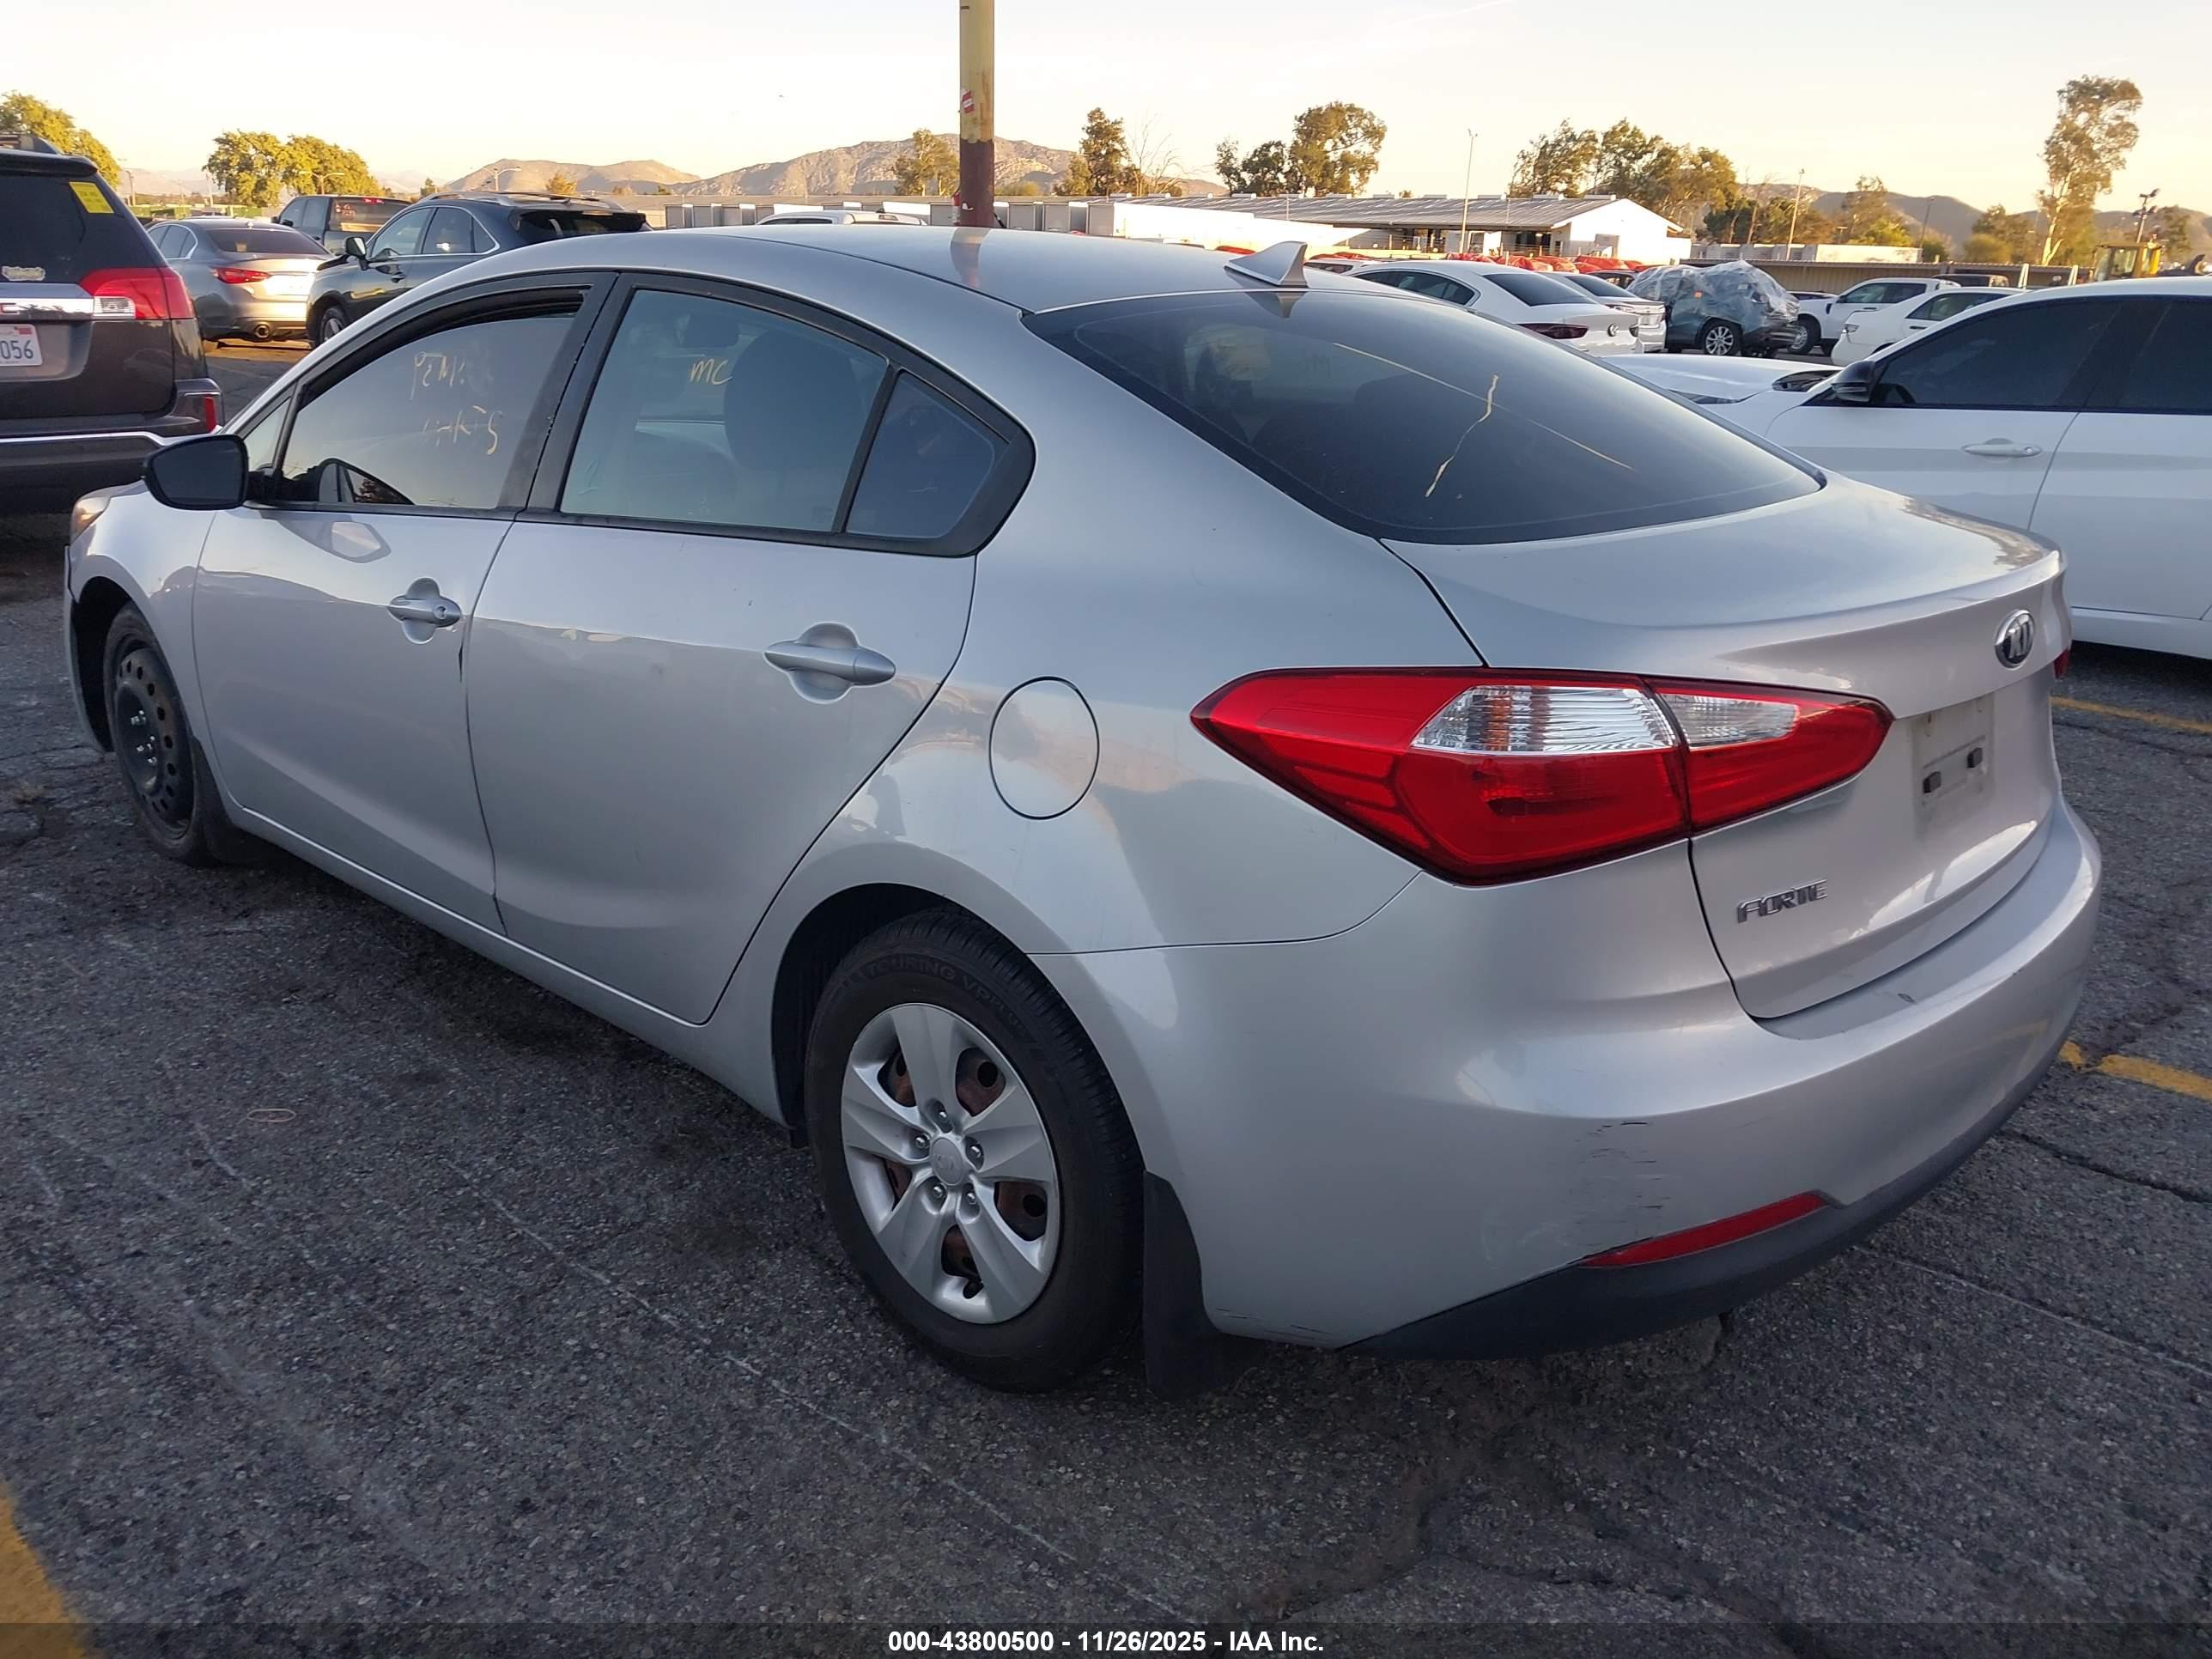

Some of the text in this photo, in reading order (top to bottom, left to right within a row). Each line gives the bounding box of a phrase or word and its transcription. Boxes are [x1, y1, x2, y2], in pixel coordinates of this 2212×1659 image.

[0, 340, 33, 359] 056
[1737, 878, 1828, 923] FORTE
[866, 955, 956, 980] TOURING
